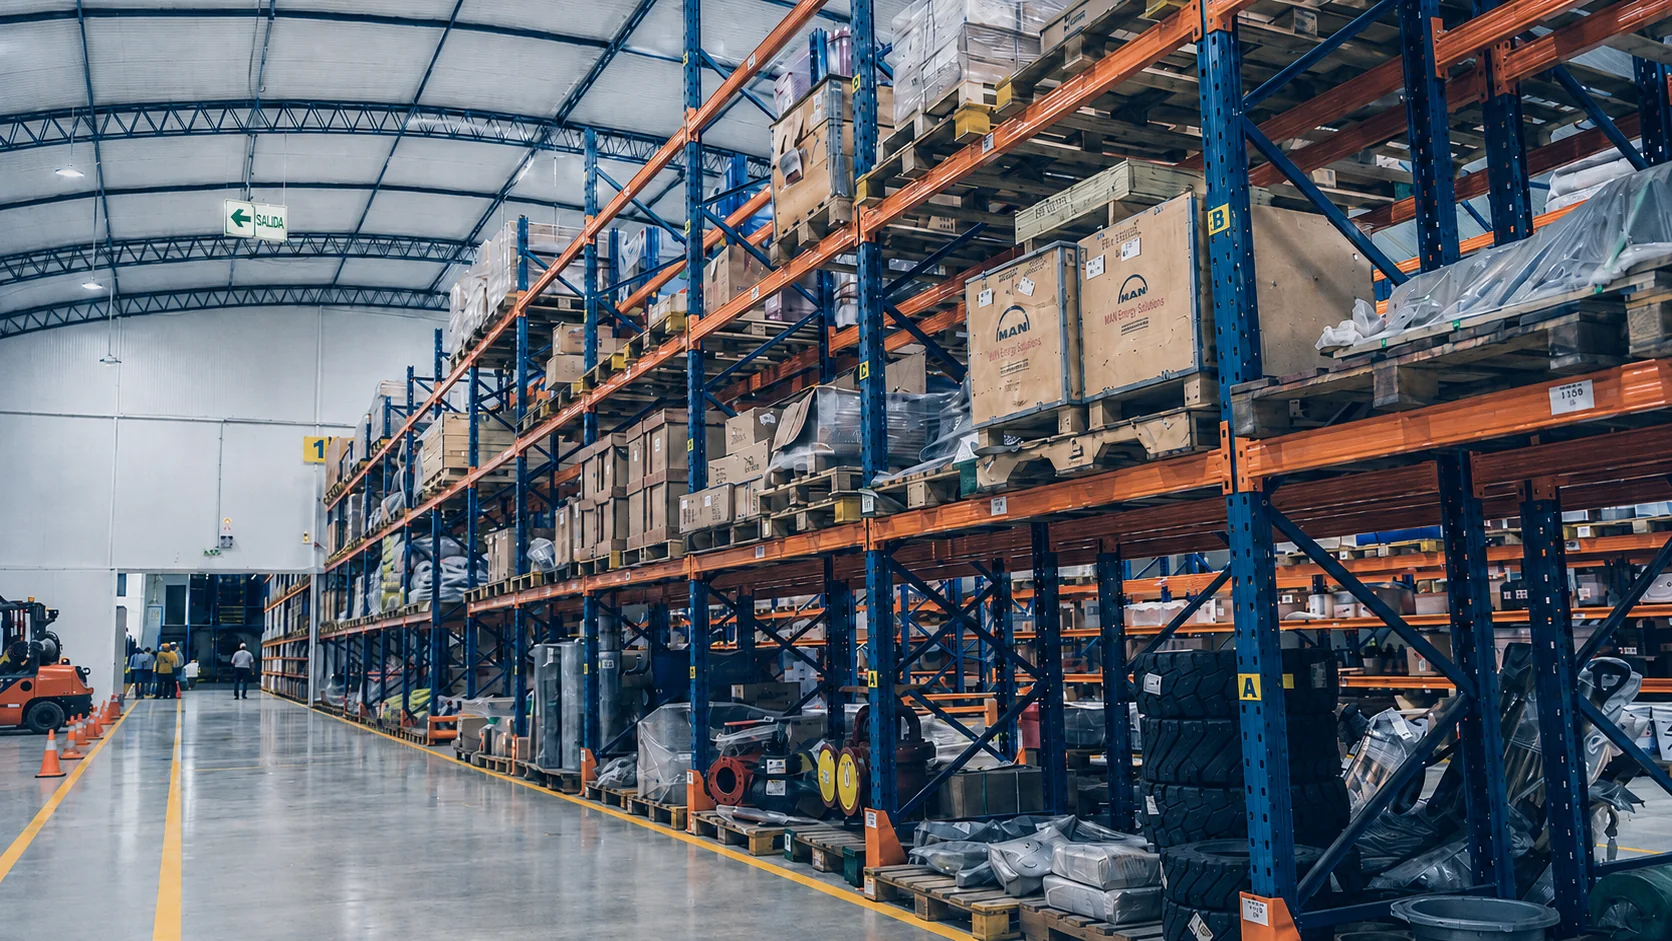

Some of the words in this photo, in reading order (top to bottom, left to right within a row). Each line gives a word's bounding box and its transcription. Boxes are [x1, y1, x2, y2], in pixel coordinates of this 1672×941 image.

[256, 214, 285, 229] SALIDA
[1212, 209, 1225, 231] B
[1120, 286, 1147, 303] MAN
[998, 321, 1028, 342] MAN
[313, 439, 324, 459] 1
[869, 671, 876, 687] A
[1242, 677, 1258, 698] A
